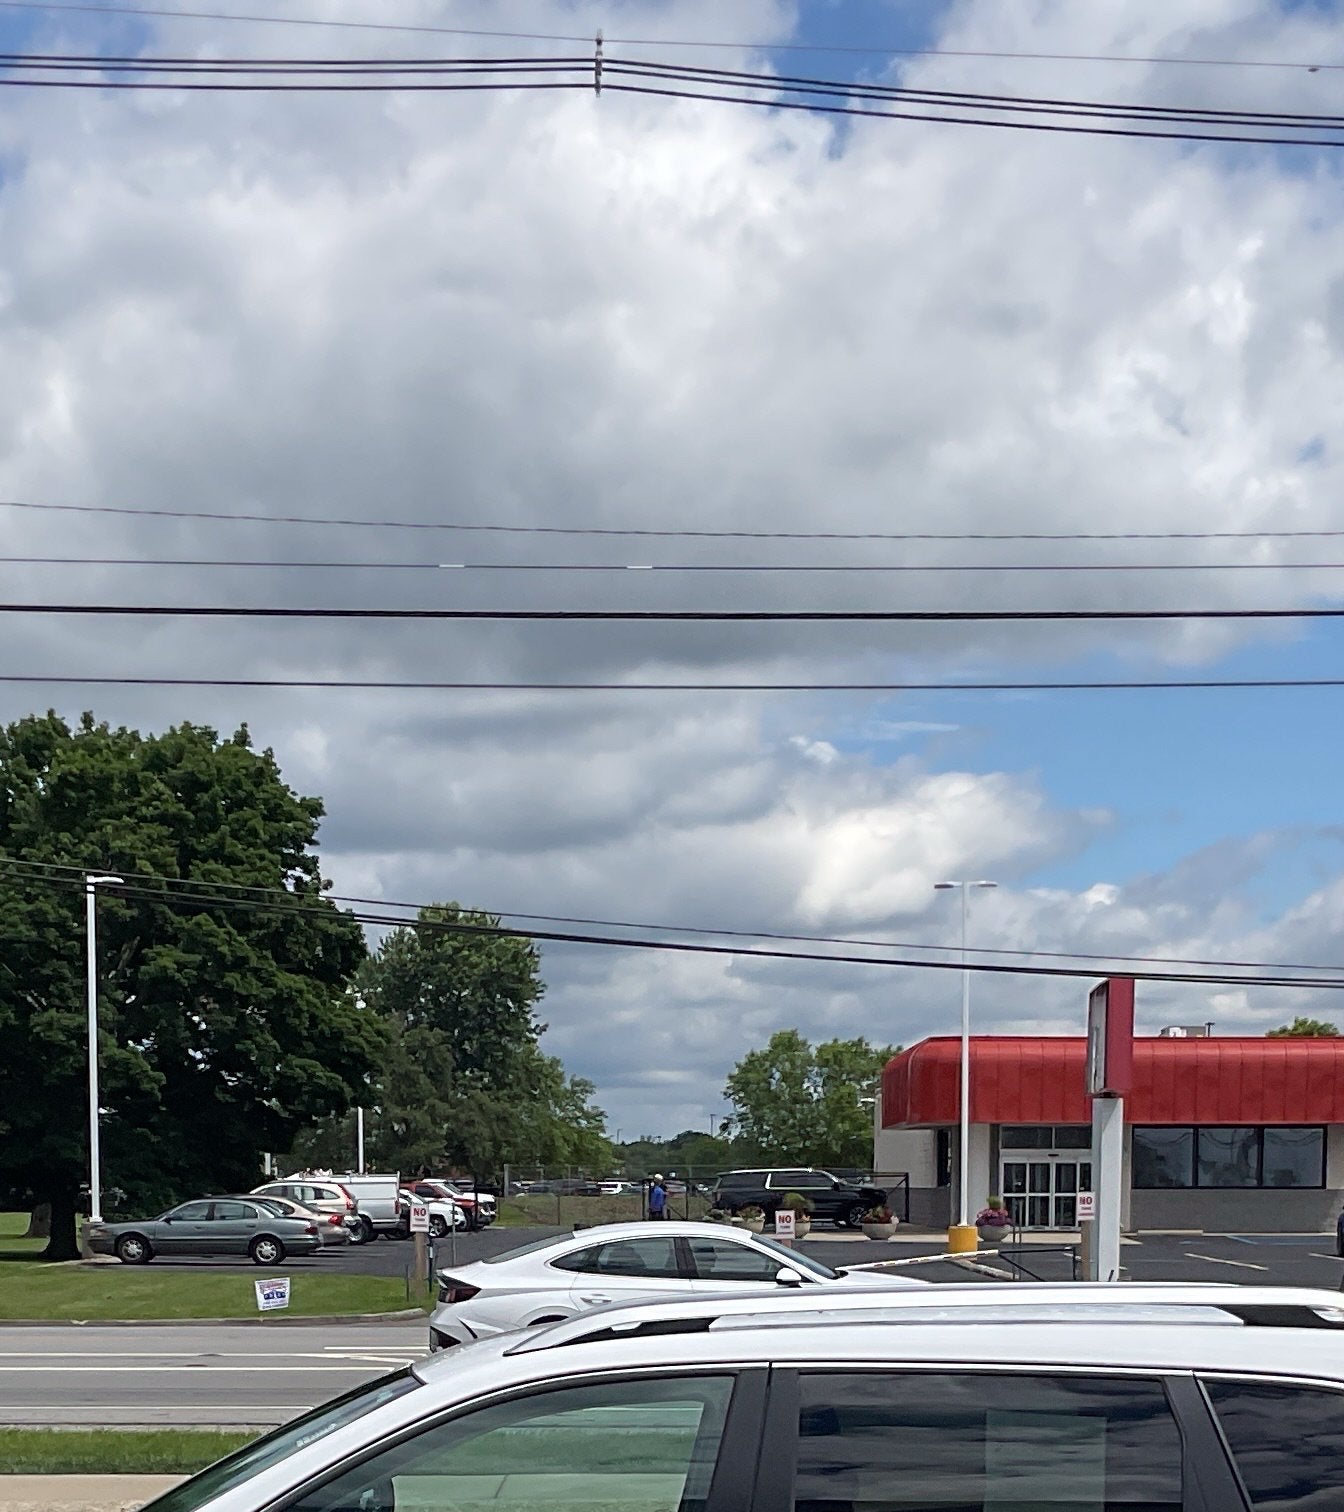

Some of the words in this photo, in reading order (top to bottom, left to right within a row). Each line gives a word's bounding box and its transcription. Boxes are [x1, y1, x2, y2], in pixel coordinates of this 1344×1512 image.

[1079, 1196, 1093, 1205] NO
[413, 1208, 427, 1217] NO
[778, 1214, 792, 1224] NO
